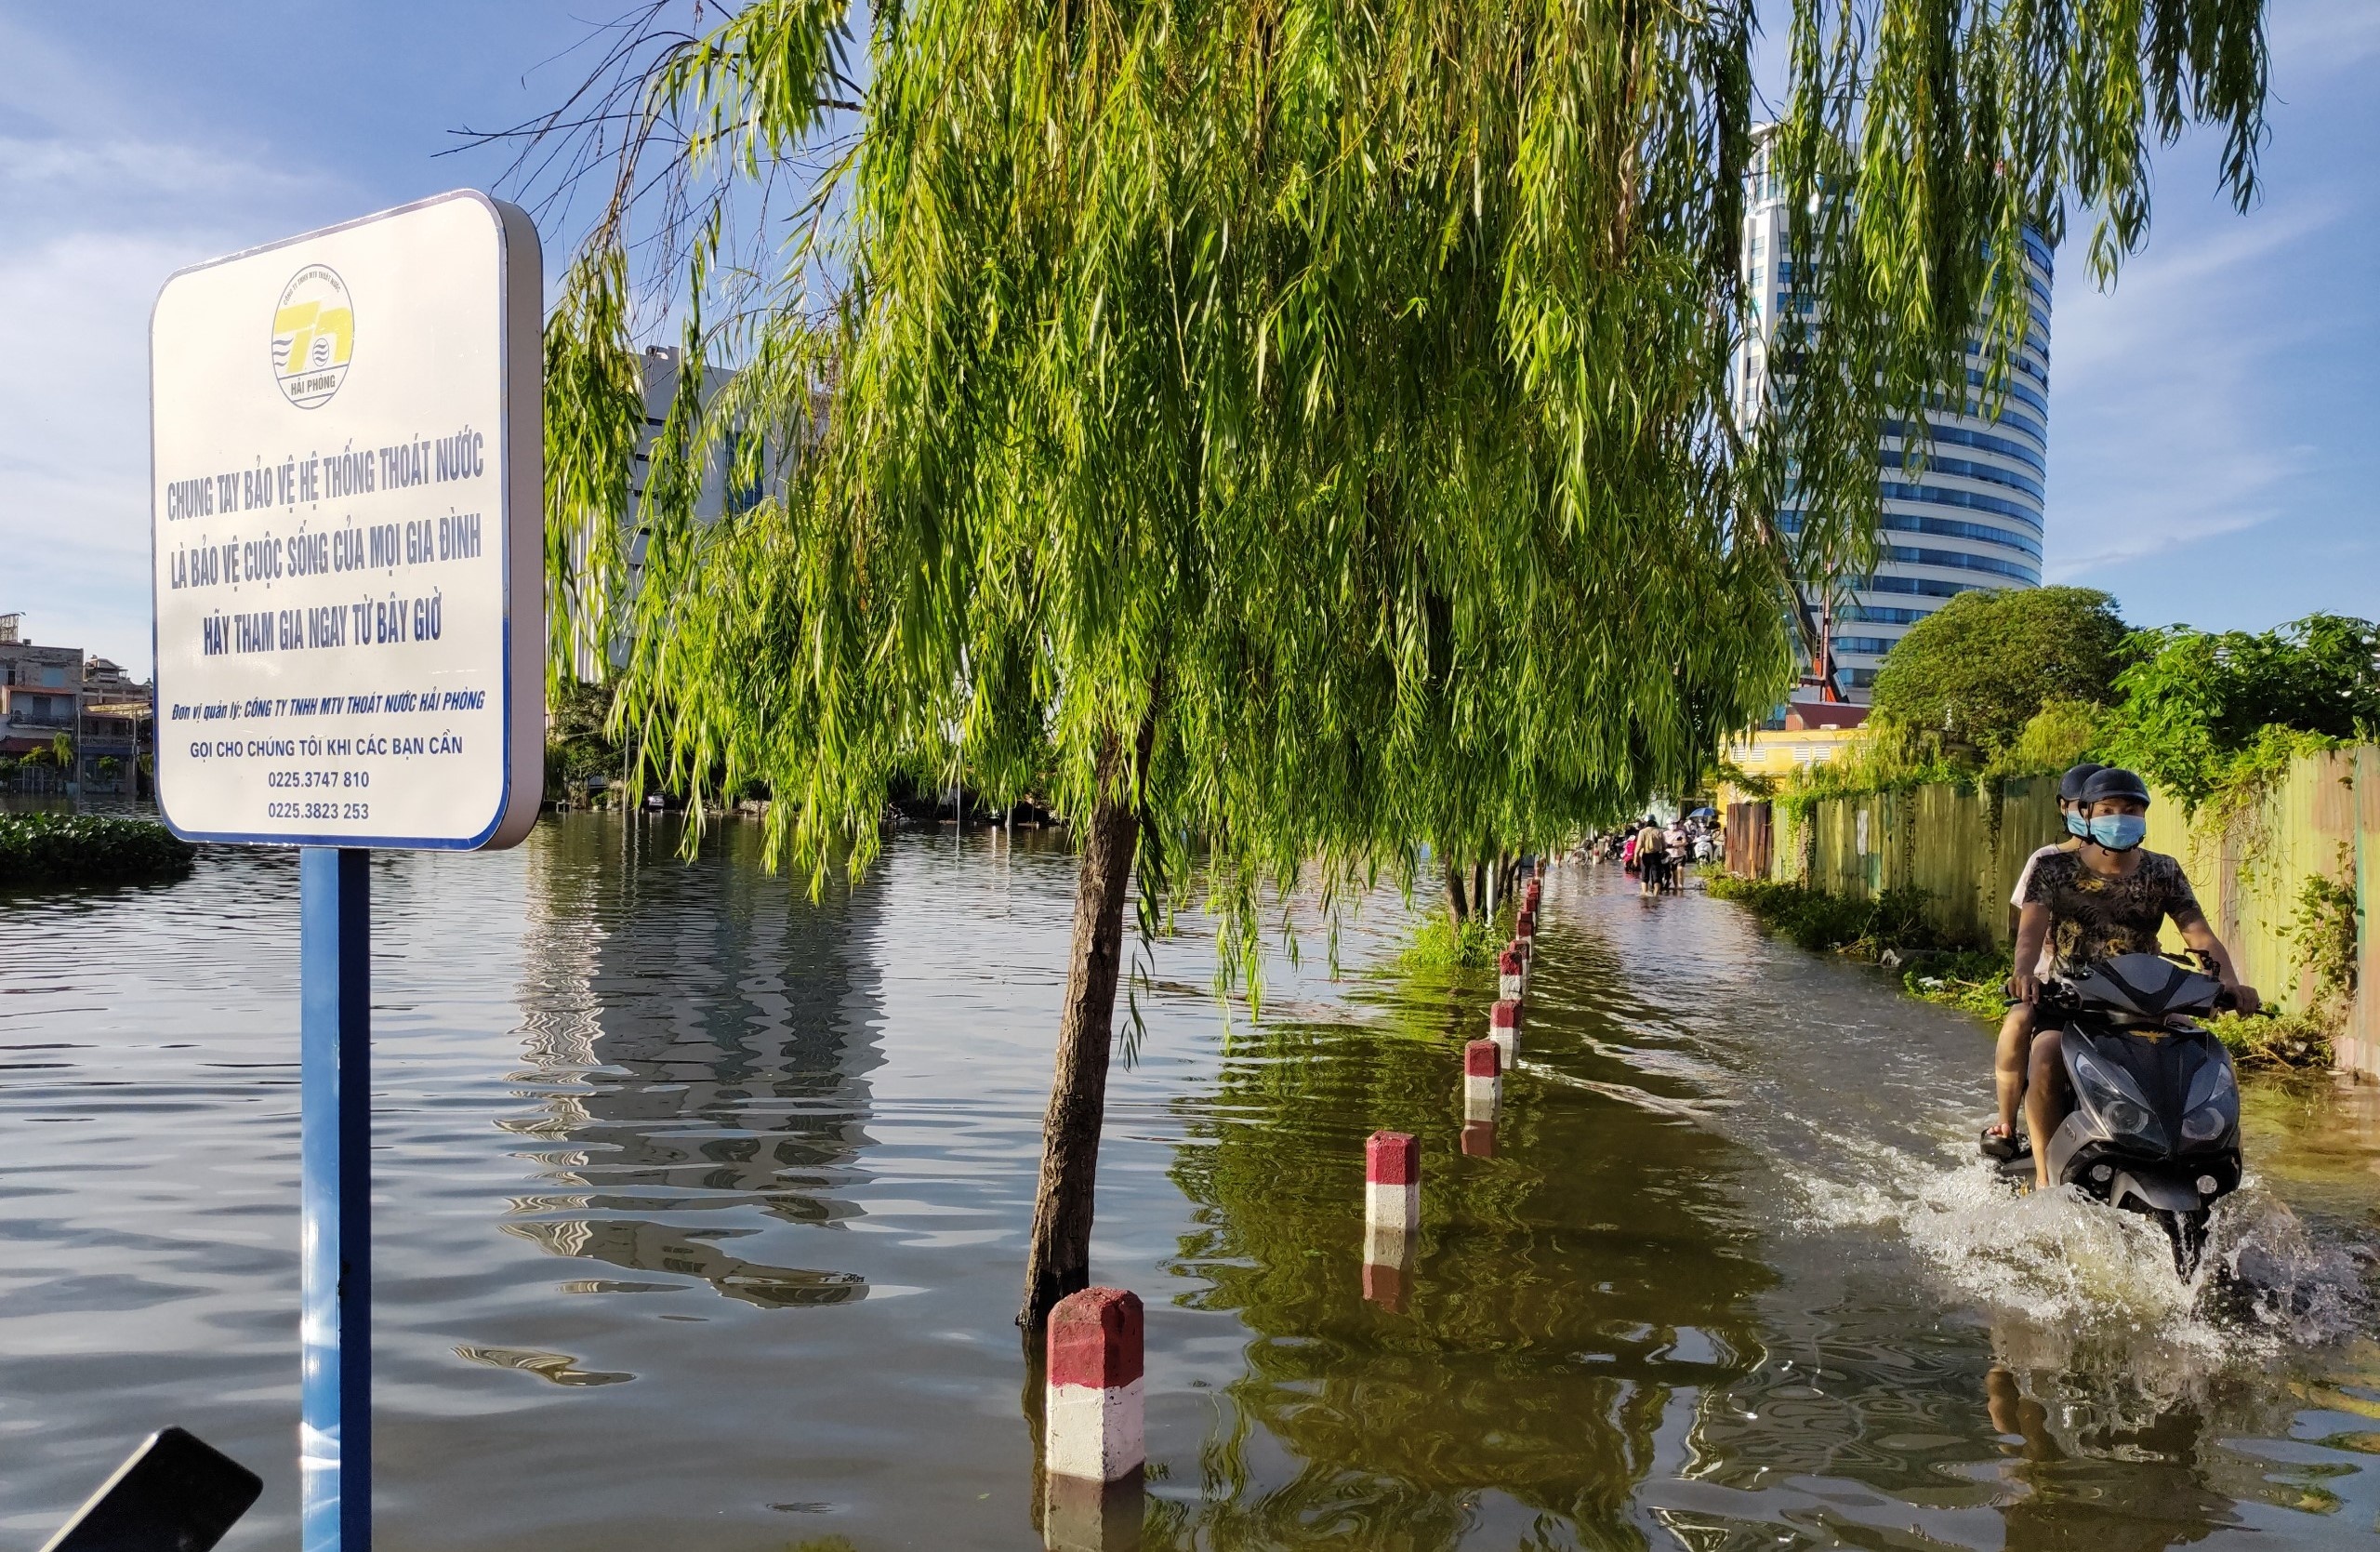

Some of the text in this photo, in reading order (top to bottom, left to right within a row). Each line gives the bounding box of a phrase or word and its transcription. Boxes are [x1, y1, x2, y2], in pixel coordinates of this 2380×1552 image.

[291, 374, 336, 395] HẢI PHÒNG
[168, 424, 484, 522] CHUNG TAY BẢO VỆ HỆ THỐNG THOÁT NƯỚC
[171, 507, 482, 592] LÀ BẢO VỆ CUỘC SỐNG CỦA MỌI GIA ĐÌNH
[204, 586, 443, 656] HÃY THAM GIA NGAY TỪ BÂY GIỜ
[172, 686, 486, 724] Đơn vị quản lý: CÔNG TY TNHH MTV THOÁT NƯỚC HẢI PHÒNG
[191, 729, 463, 763] GỌI CHO CHÚNG TÔI KHI CÁC BẠN CẦN
[268, 772, 369, 788] 0225.3747 810
[268, 803, 369, 819] 0225.3823 253
